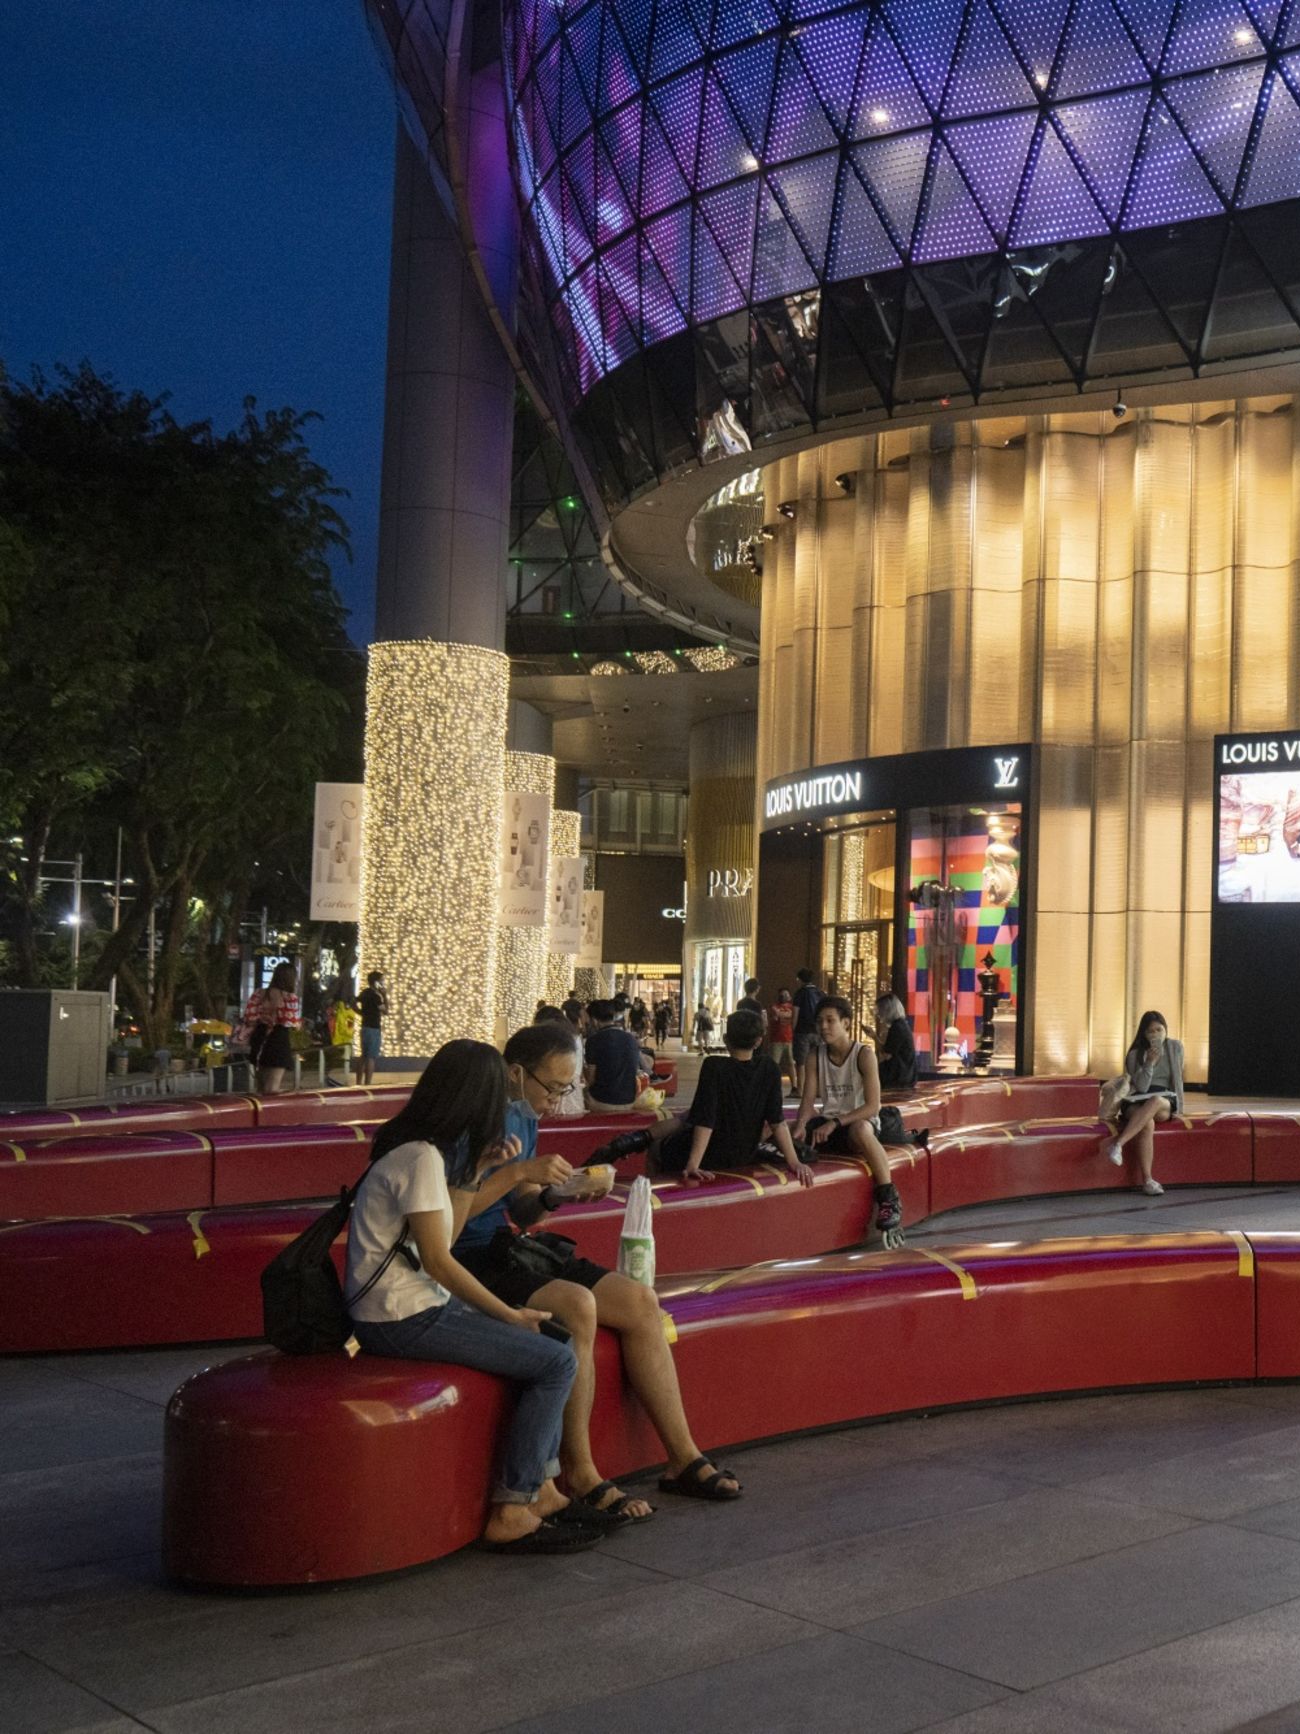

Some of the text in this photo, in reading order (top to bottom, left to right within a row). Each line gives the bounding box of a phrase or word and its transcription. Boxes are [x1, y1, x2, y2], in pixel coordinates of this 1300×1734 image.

[1222, 741, 1279, 764] LOUIS
[994, 757, 1019, 788] LV
[766, 771, 861, 818] LOUIS VUITTON
